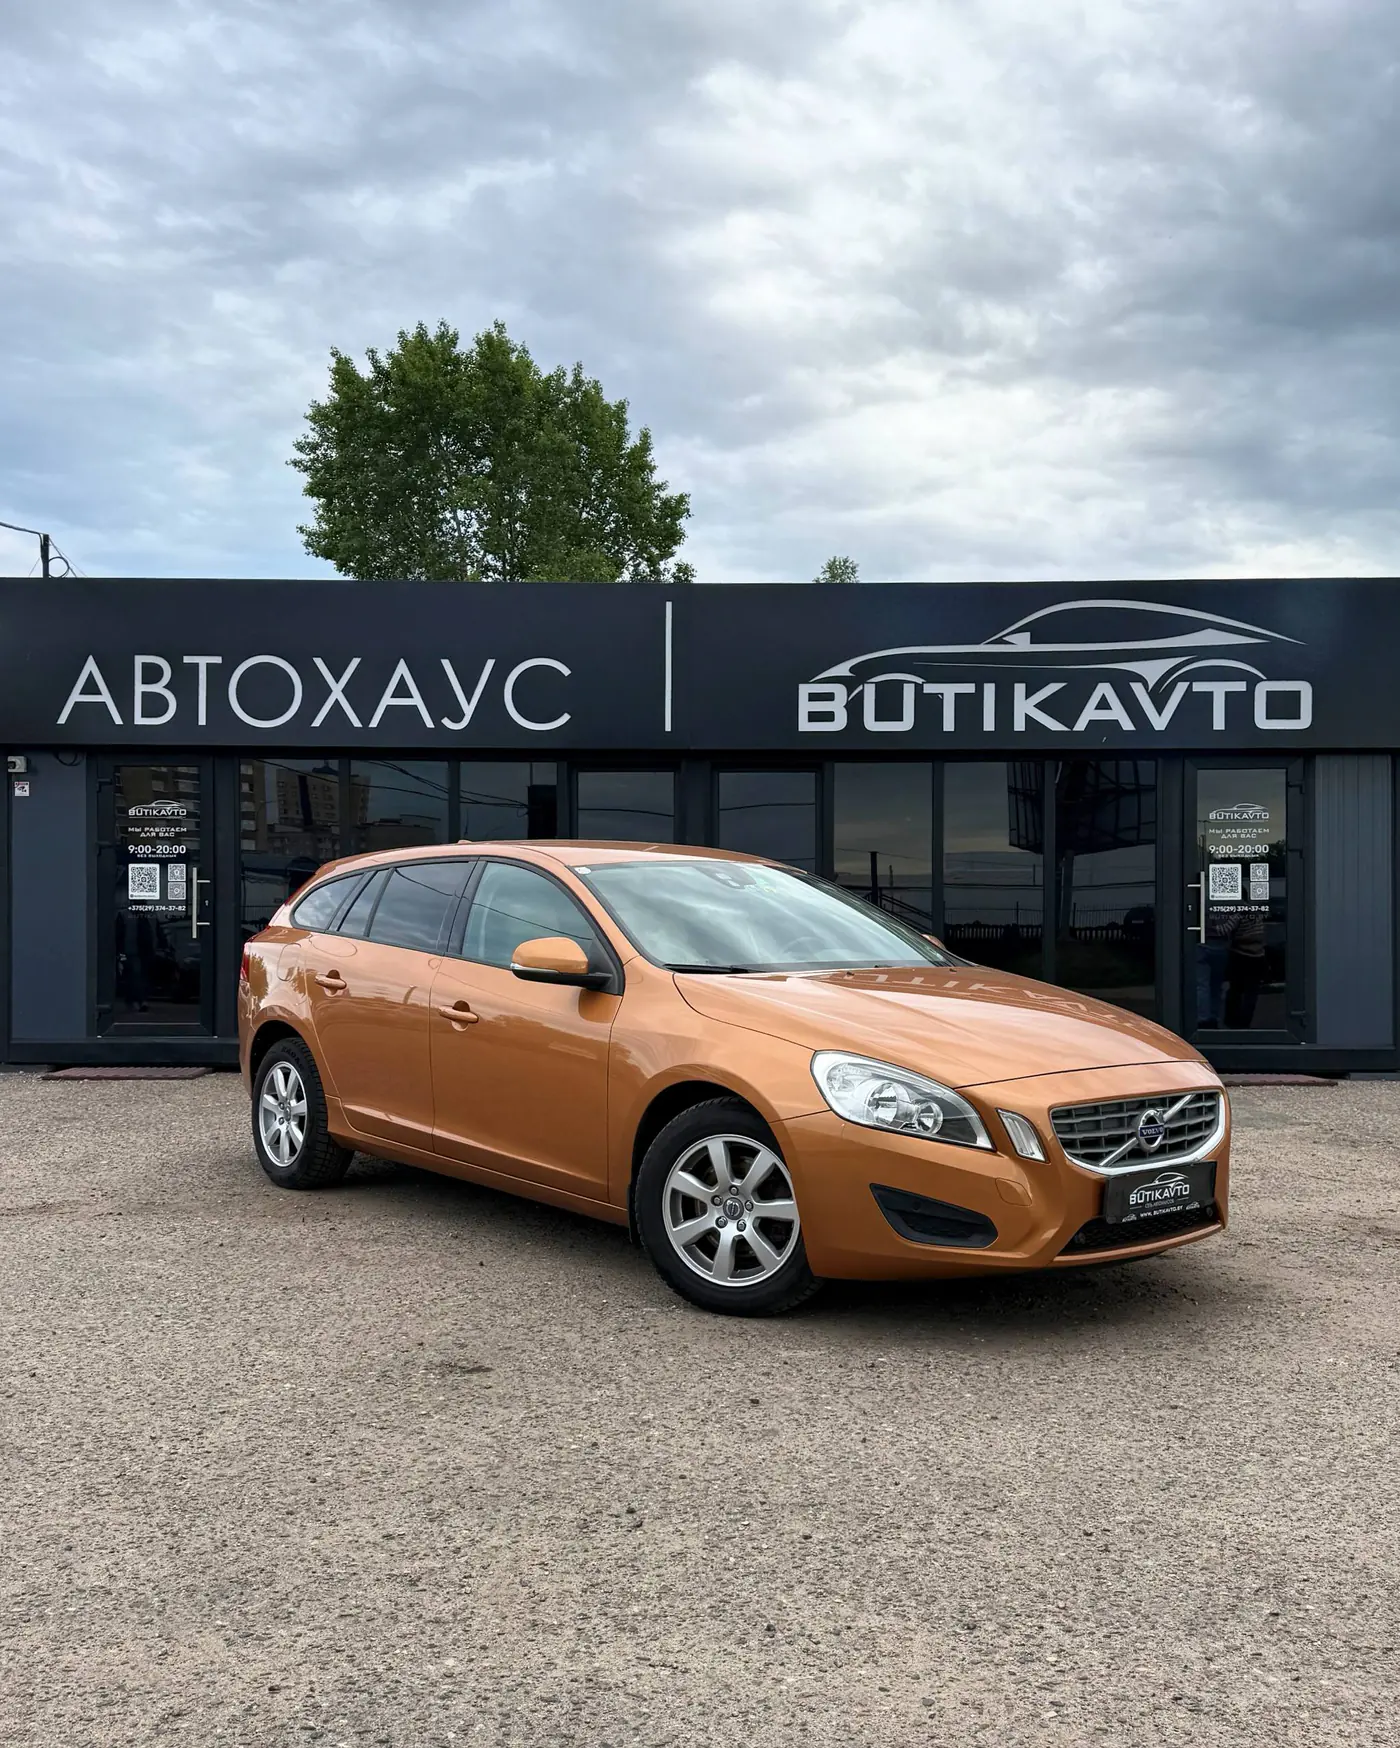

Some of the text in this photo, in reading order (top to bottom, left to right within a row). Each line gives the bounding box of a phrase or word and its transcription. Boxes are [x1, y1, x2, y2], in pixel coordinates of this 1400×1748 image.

[56, 654, 572, 731] АВТОХАУС
[798, 680, 1313, 732] BUTIKAVTO
[128, 808, 187, 816] BUTIKAVTO
[1209, 812, 1270, 820] BUTIKAVTO
[128, 844, 187, 854] 9:00-20:00
[1208, 844, 1270, 854] 9:00-20:00
[1142, 1127, 1164, 1135] VOLVO
[1129, 1185, 1190, 1204] BUTIKAVTO
